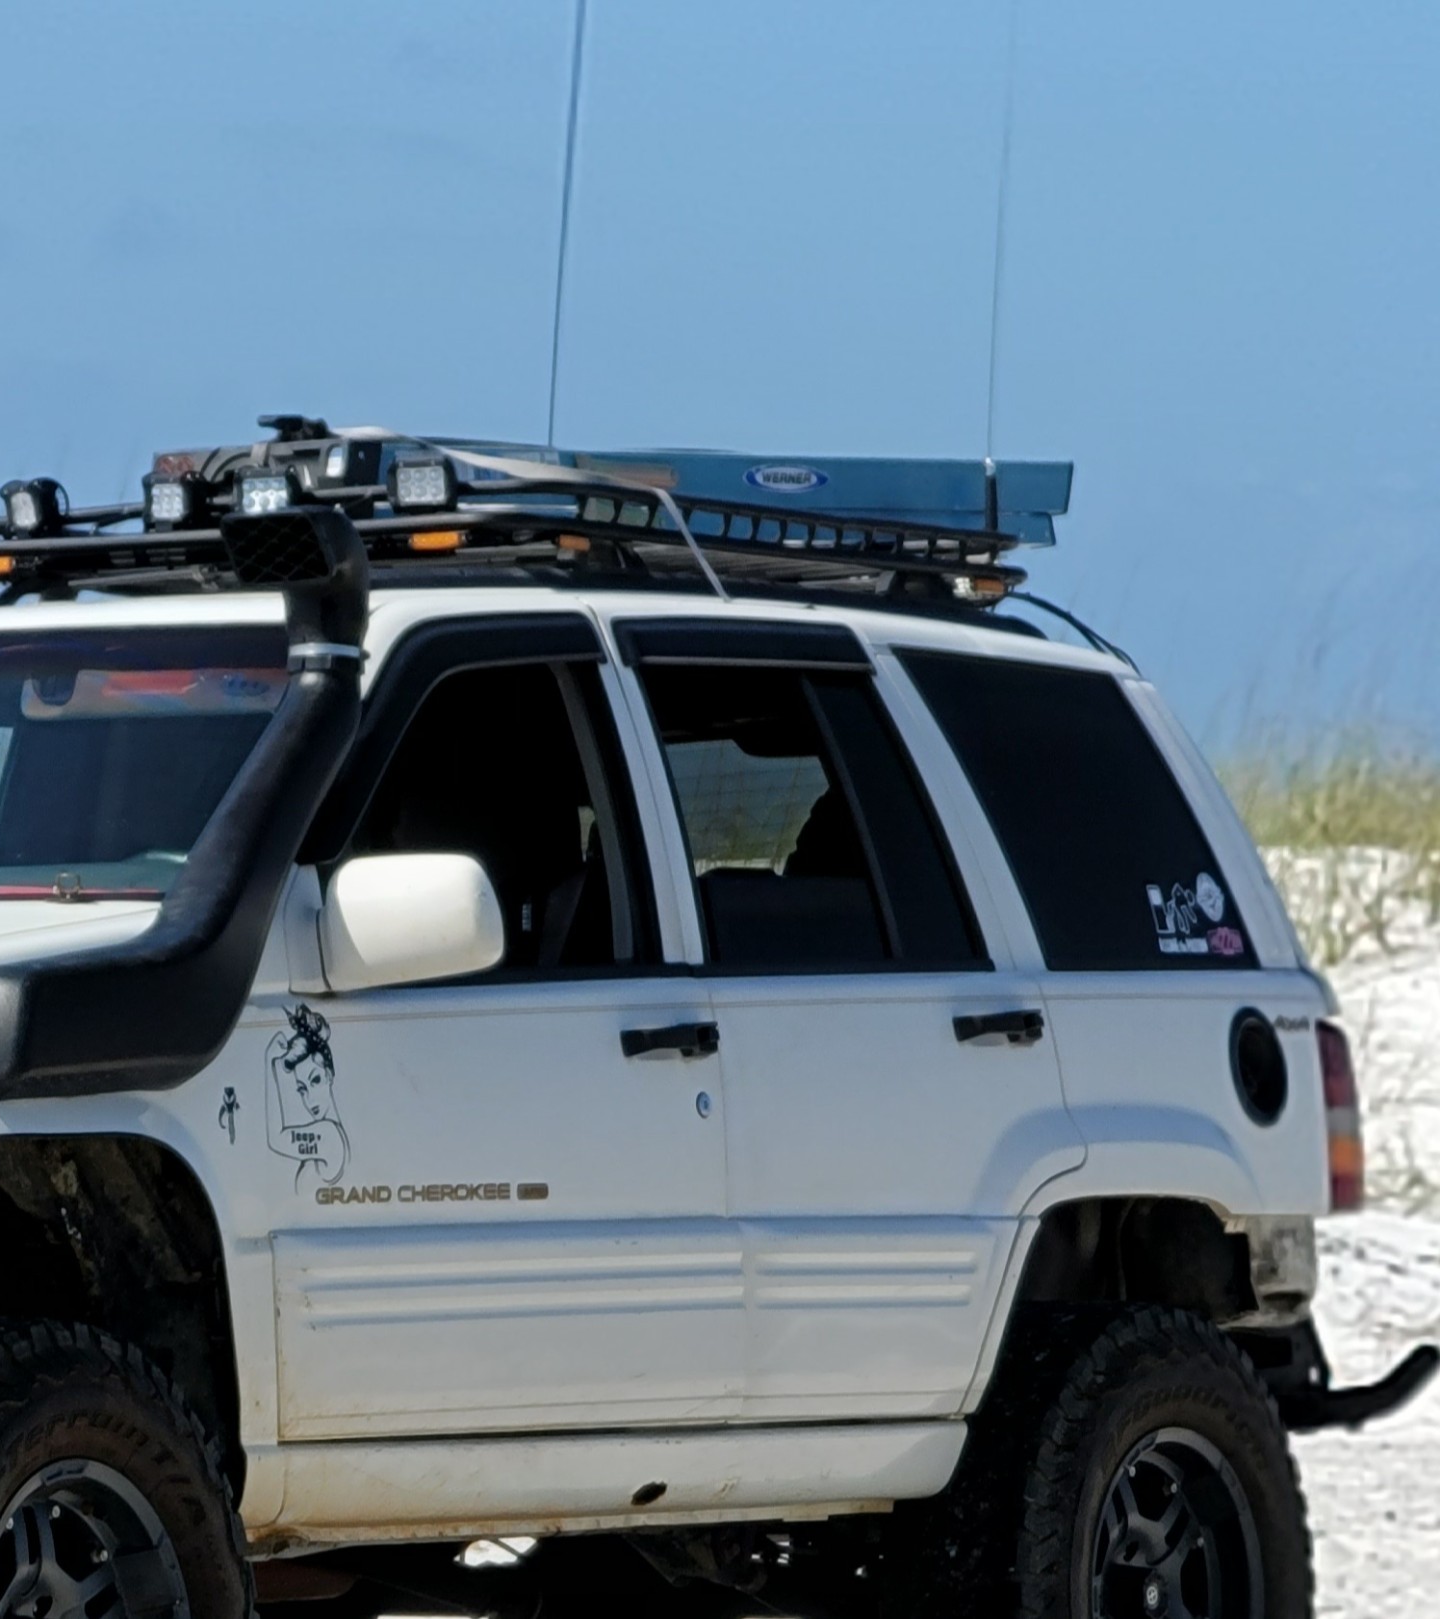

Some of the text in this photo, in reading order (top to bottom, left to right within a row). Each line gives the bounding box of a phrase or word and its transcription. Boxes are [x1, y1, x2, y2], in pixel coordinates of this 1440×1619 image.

[762, 471, 812, 485] WERNER
[291, 1130, 315, 1144] Jeep
[298, 1143, 318, 1155] Girl
[315, 1185, 392, 1205] GRAND
[397, 1182, 511, 1203] CHEROKEE
